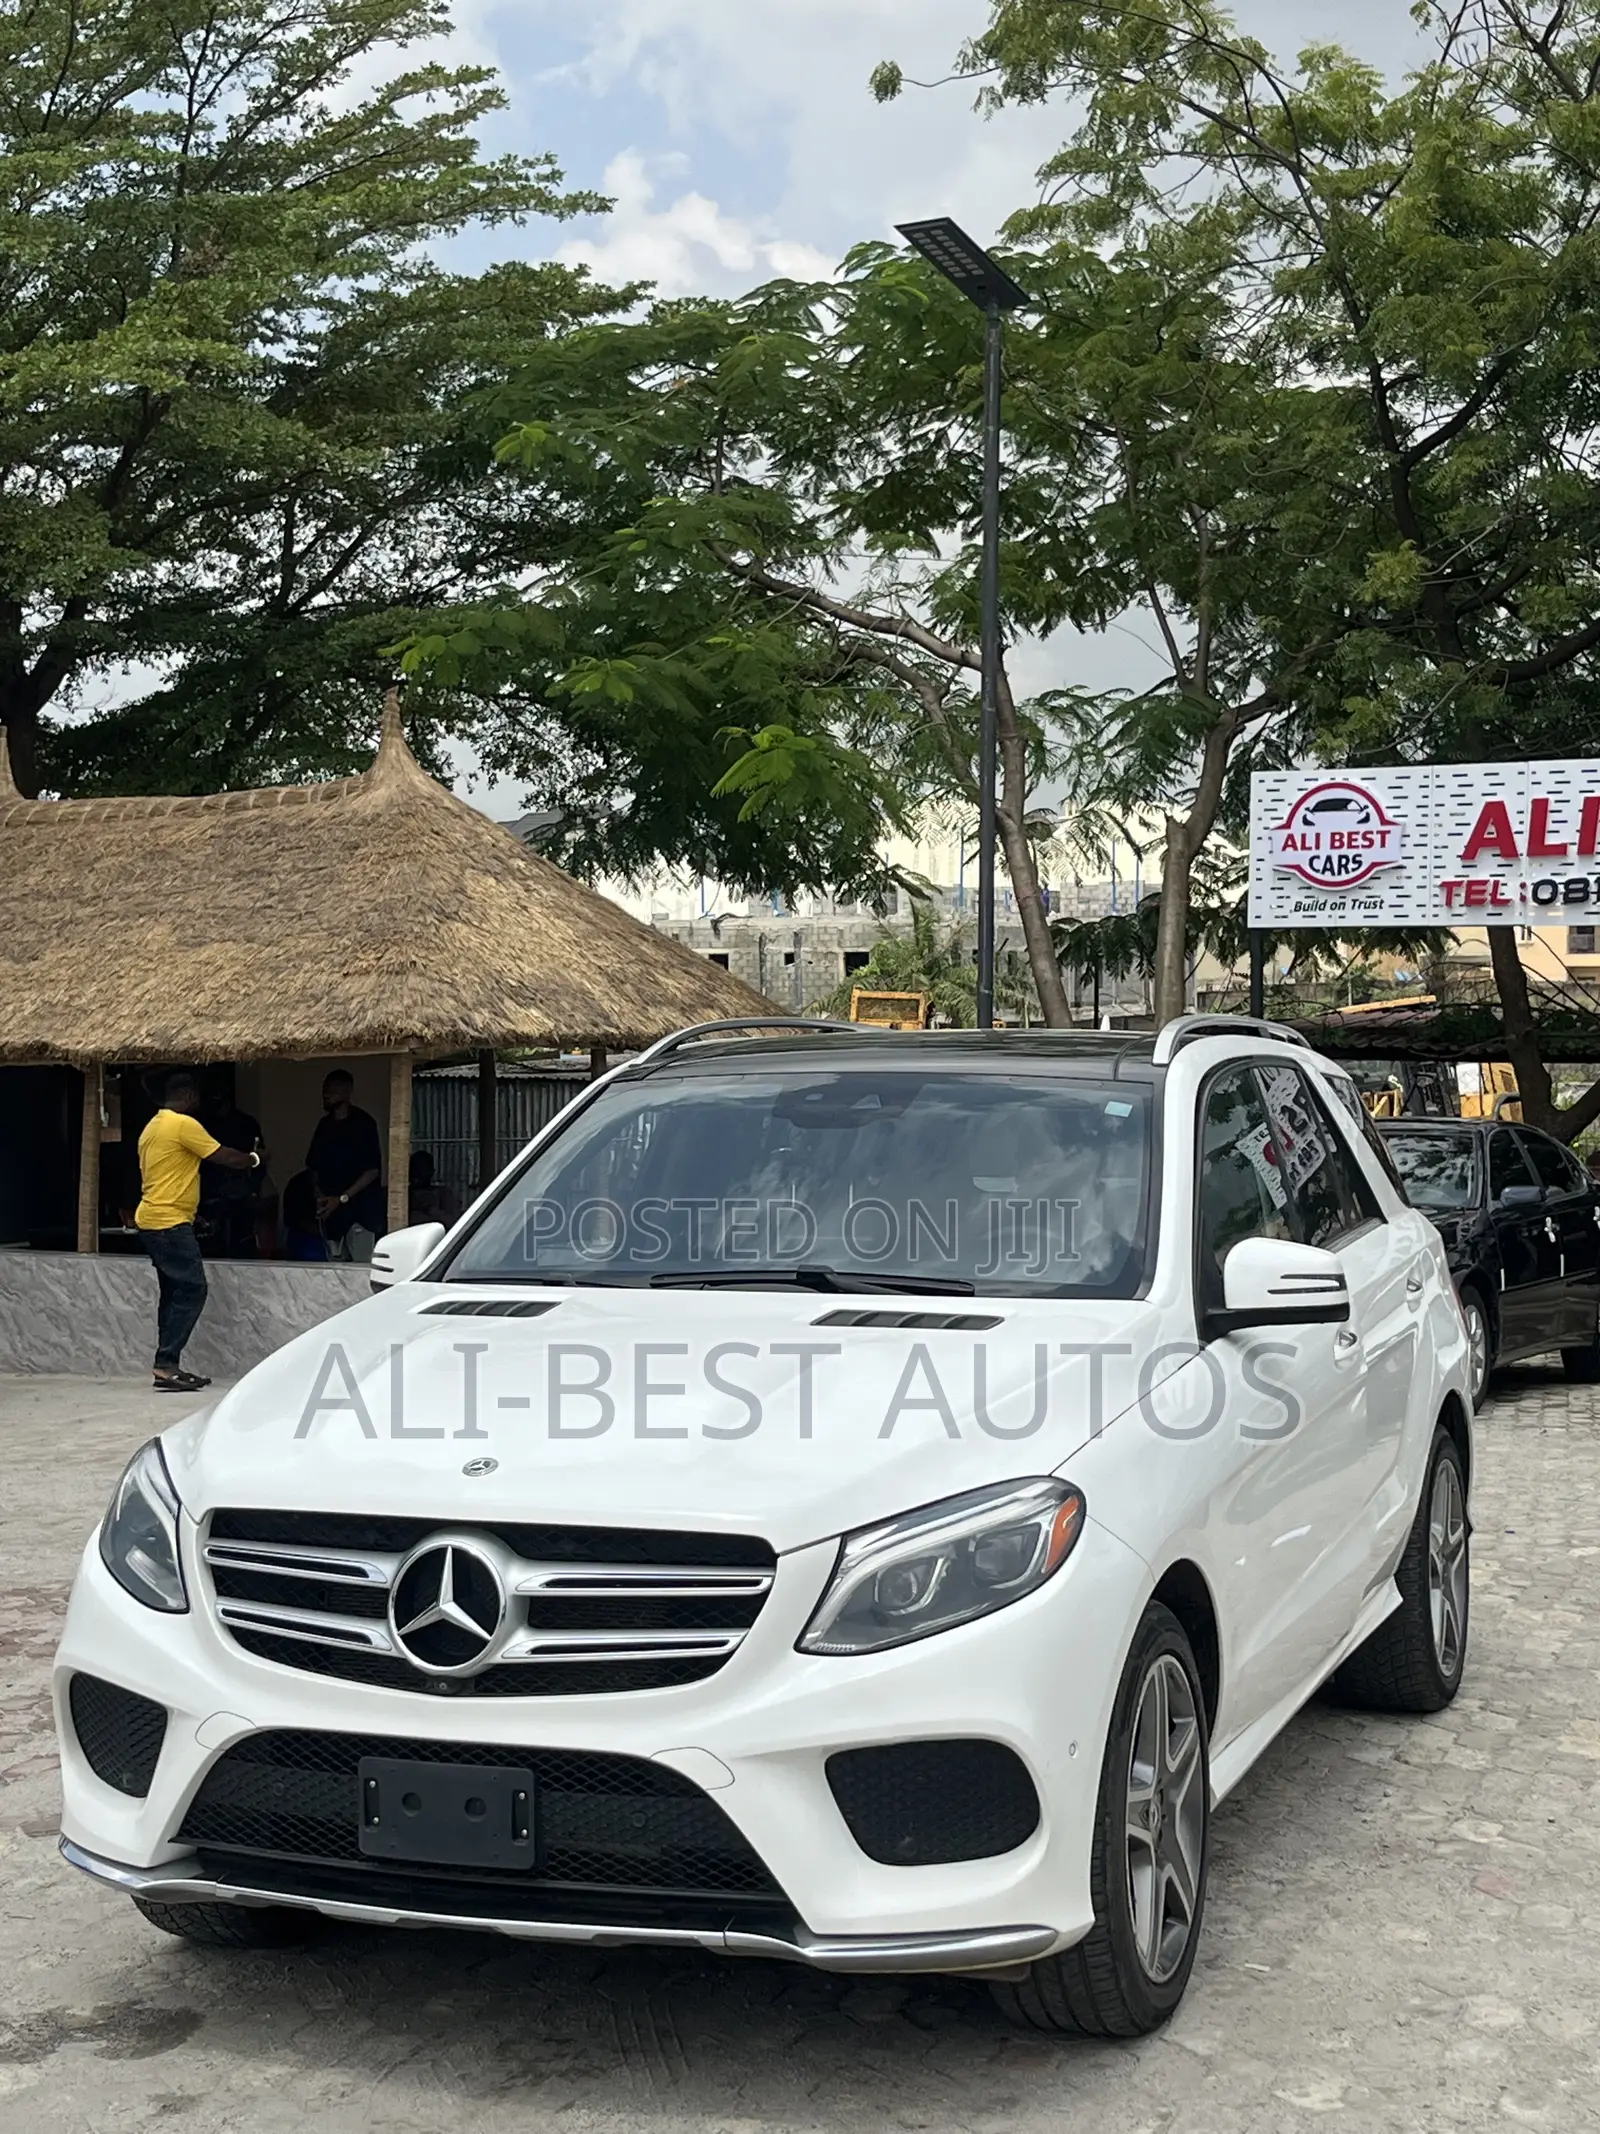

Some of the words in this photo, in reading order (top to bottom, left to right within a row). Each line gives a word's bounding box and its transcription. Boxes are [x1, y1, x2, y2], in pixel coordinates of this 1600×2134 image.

[1459, 795, 1600, 861] ALI
[1281, 832, 1321, 852] ALI
[1329, 829, 1391, 851] BEST
[1308, 853, 1363, 876] CARS
[1293, 899, 1328, 913] Build
[1330, 901, 1346, 911] on
[1351, 898, 1385, 910] Trust
